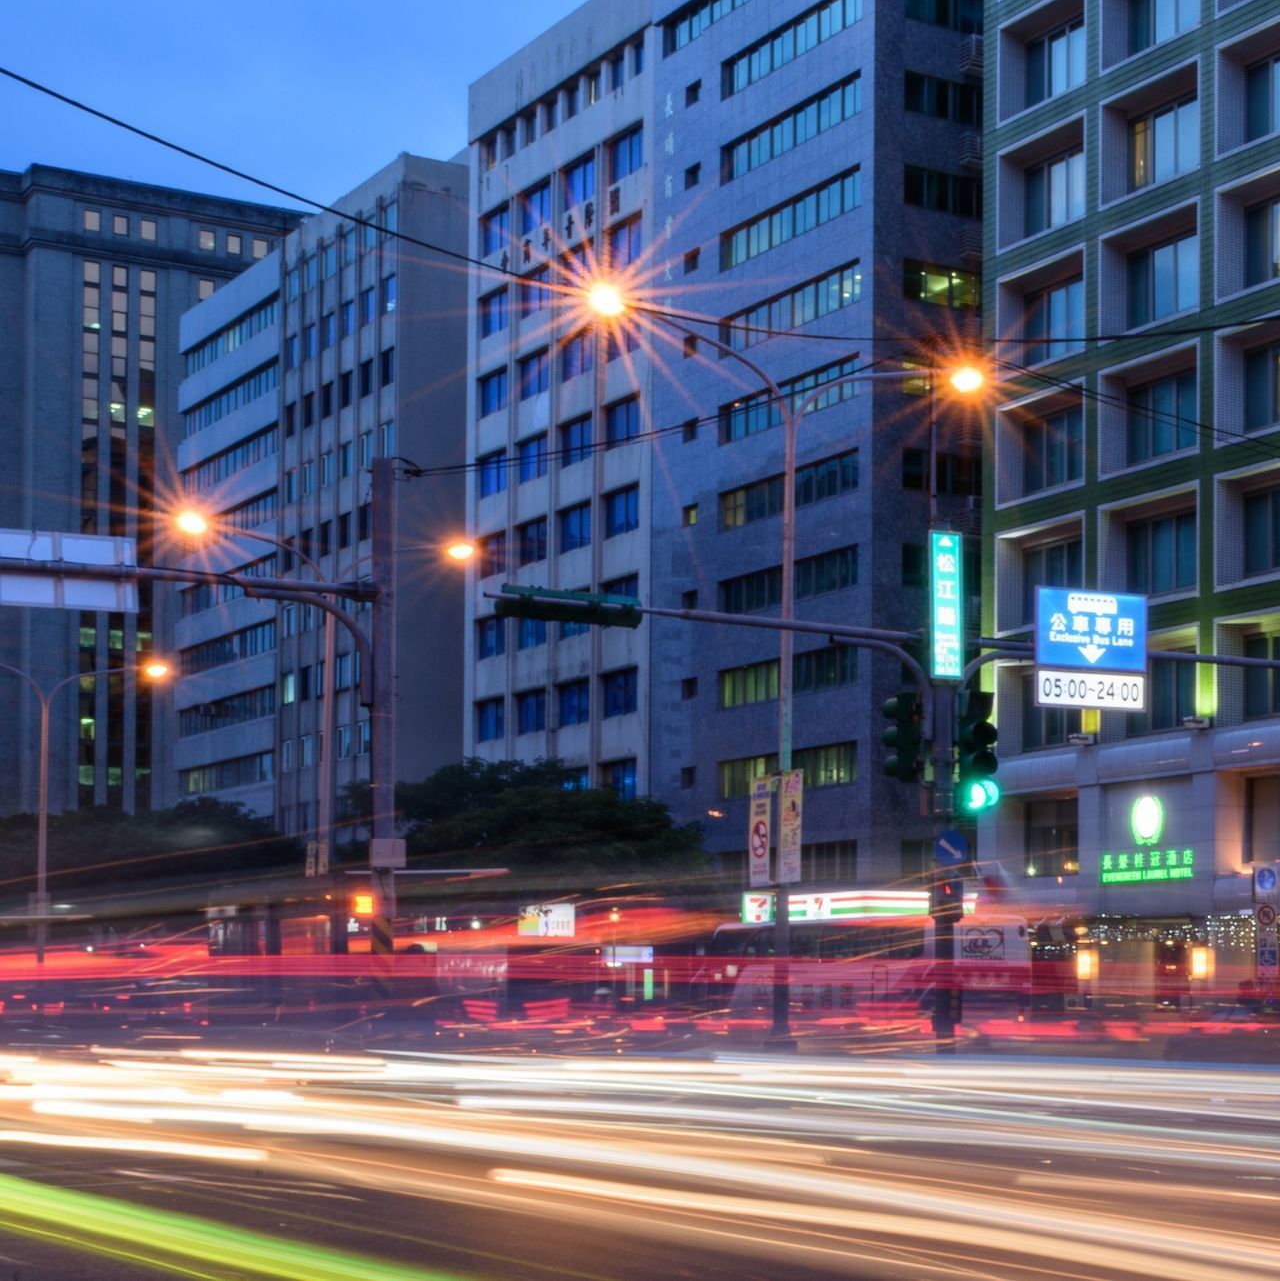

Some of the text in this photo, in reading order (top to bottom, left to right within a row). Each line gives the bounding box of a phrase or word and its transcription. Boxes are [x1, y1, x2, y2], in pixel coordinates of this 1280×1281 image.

[1050, 613, 1135, 637] 公車專用
[1111, 635, 1135, 648] Lane
[1043, 677, 1139, 702] 05:00~24:00
[1103, 849, 1194, 870] 長榮桂冠酒店
